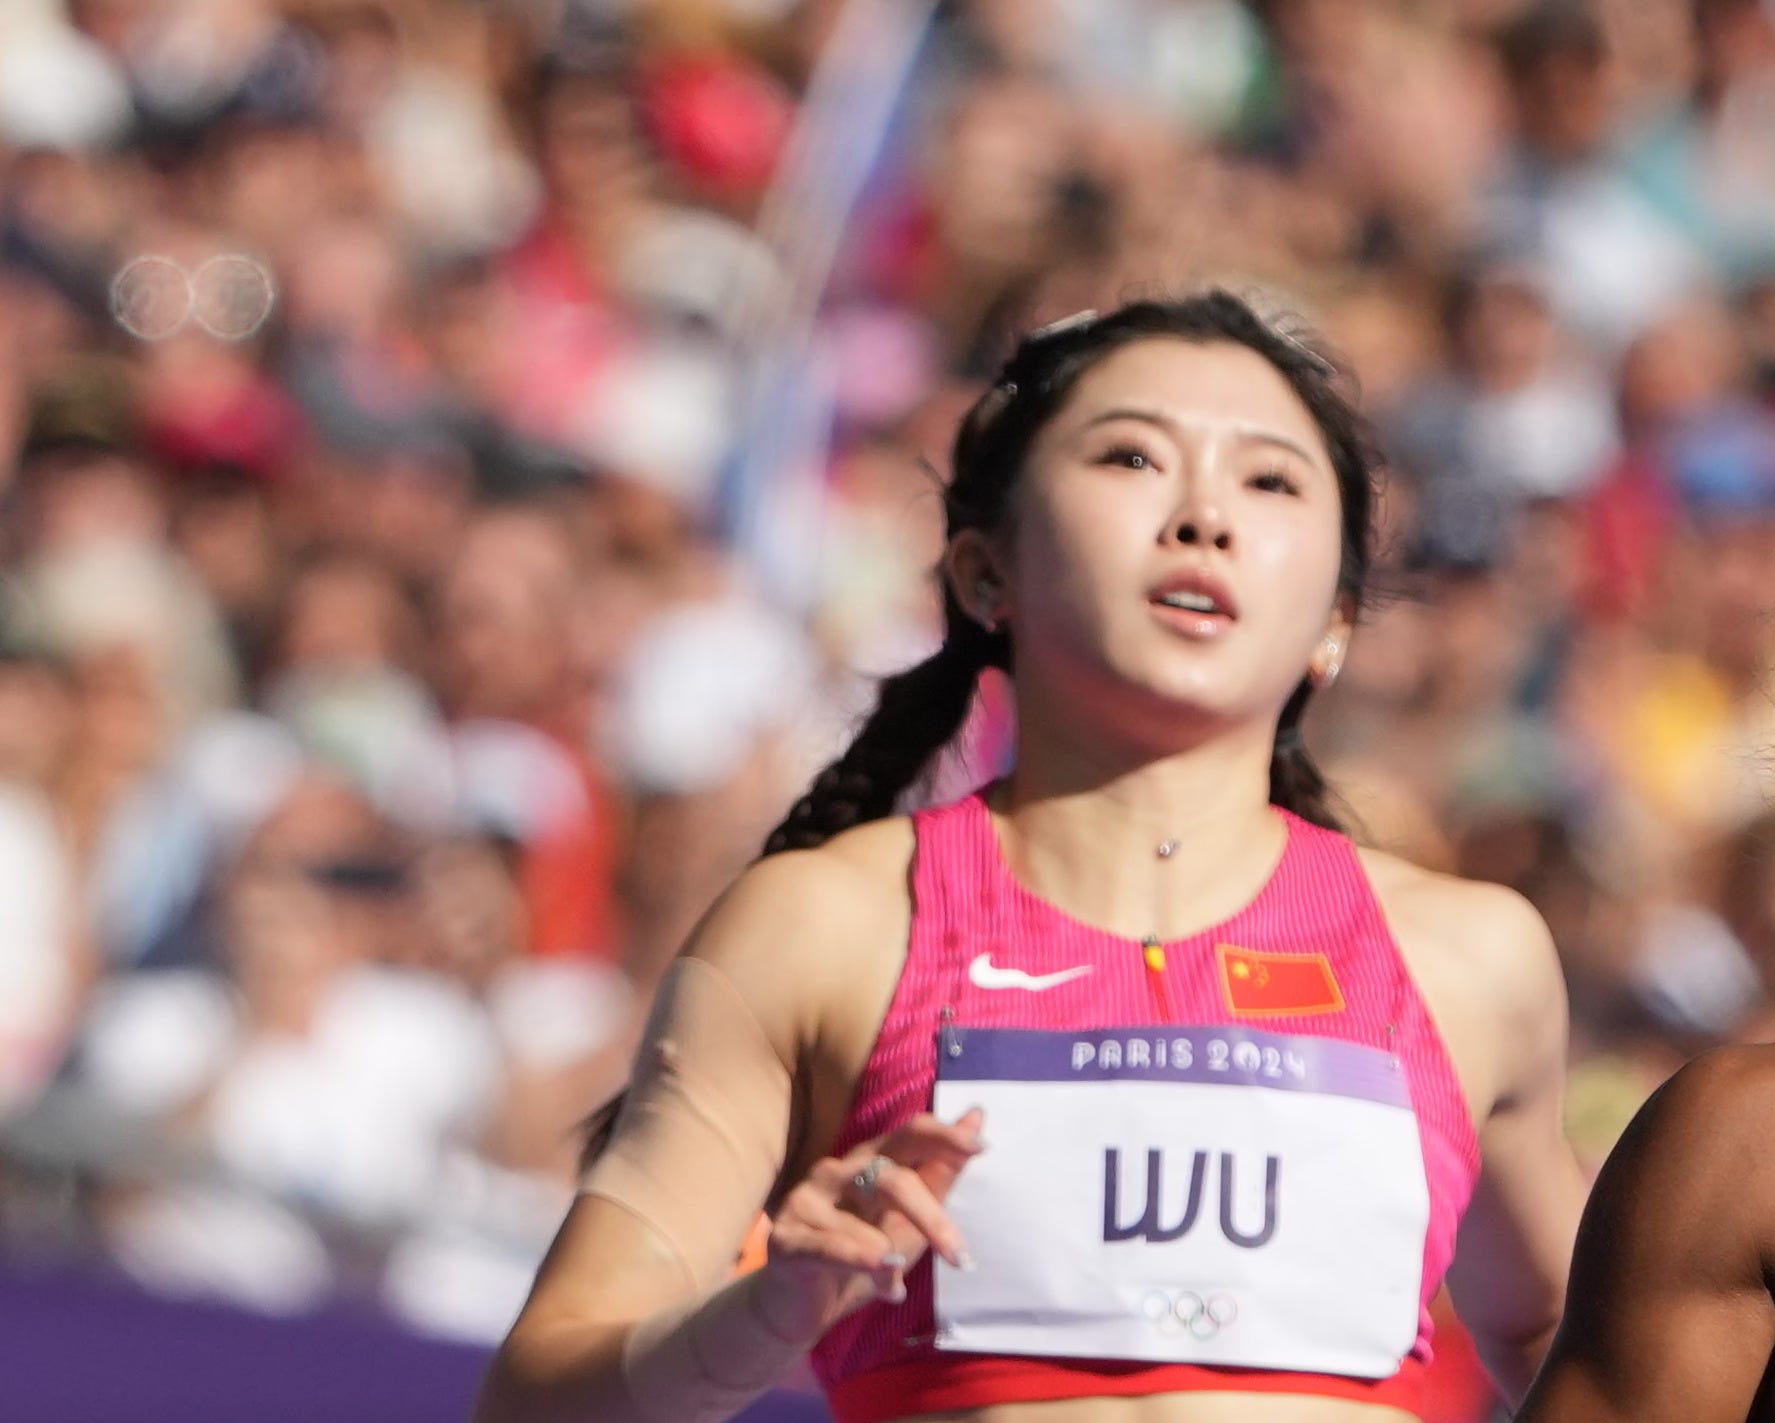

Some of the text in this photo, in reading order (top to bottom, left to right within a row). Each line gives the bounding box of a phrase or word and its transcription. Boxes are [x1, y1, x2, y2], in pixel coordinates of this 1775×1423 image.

[1072, 1037, 1305, 1077] PARIS 2024
[1103, 1147, 1279, 1248] WU
